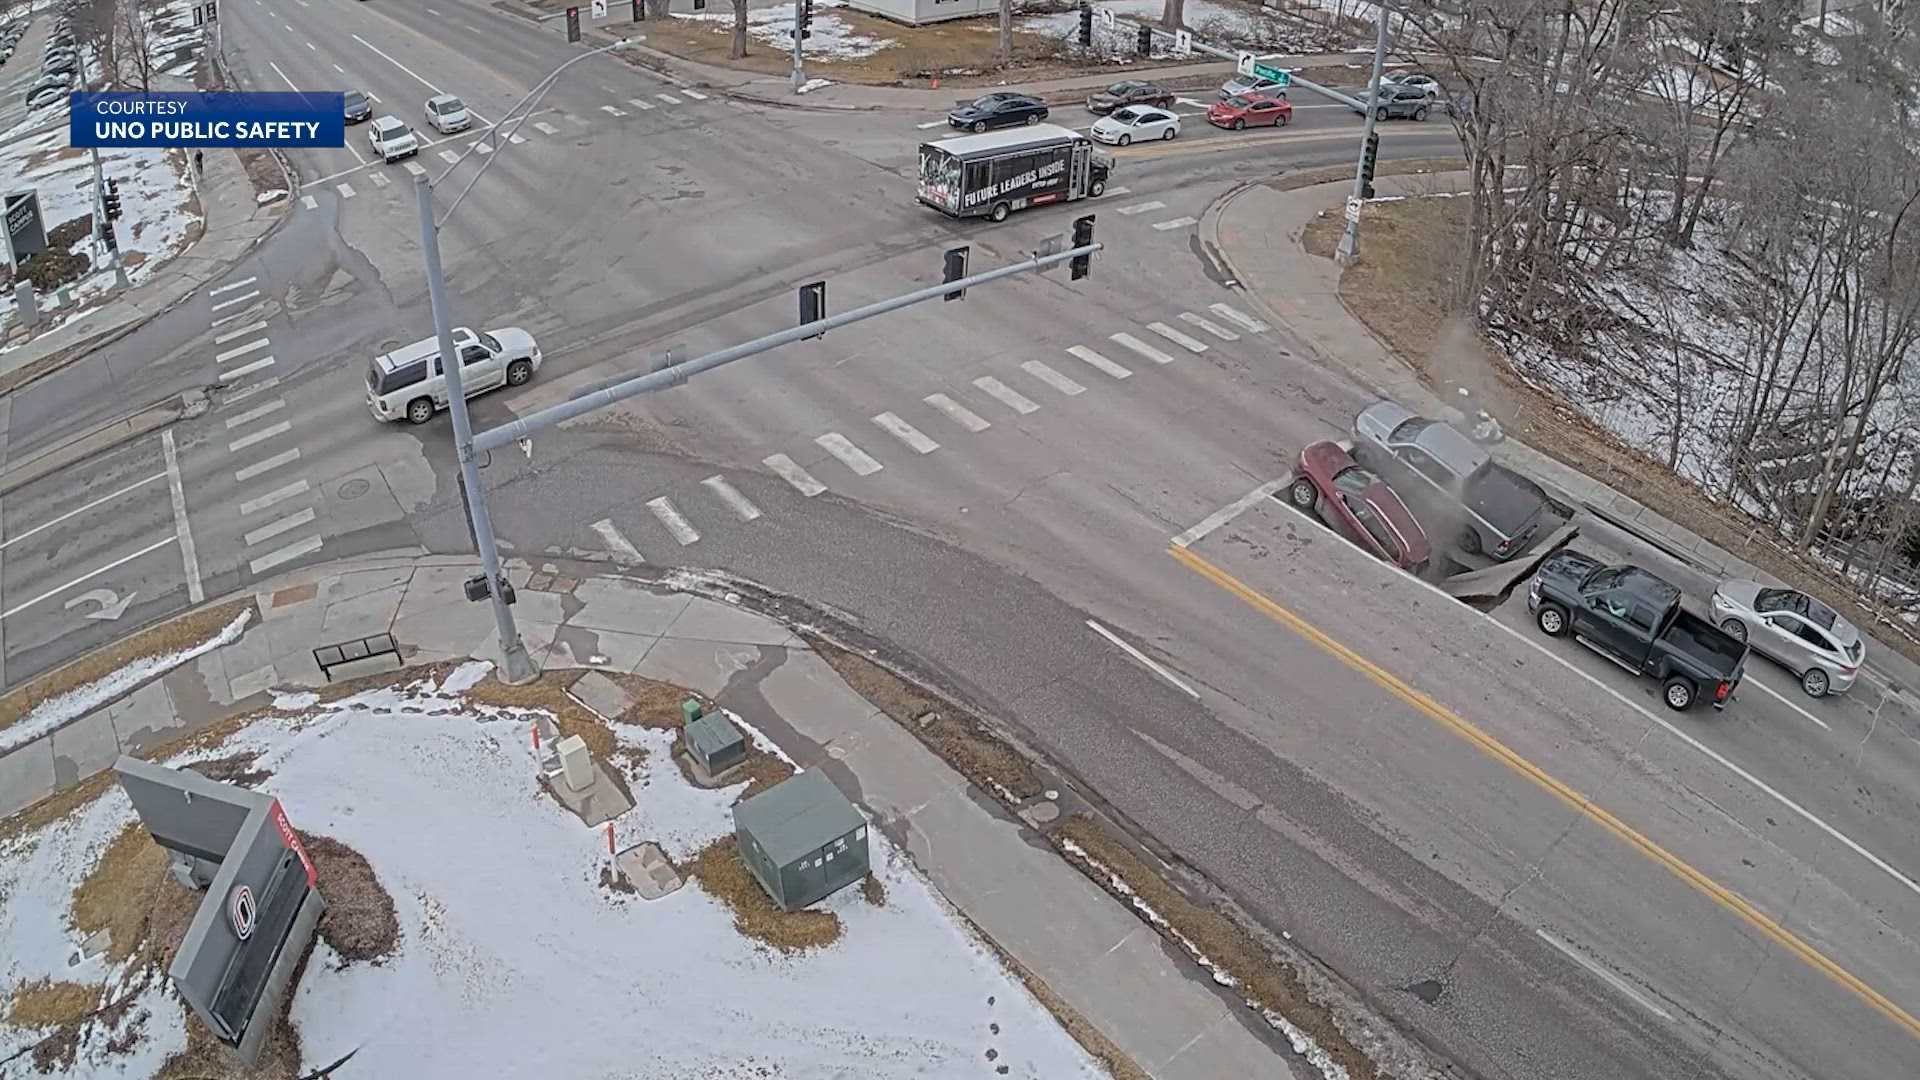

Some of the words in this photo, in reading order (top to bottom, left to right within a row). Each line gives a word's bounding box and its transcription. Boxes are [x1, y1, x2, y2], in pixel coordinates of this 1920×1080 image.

[964, 184, 999, 207] FUTURE
[1000, 170, 1037, 194] LEADERS
[1038, 160, 1065, 179] INSIDE
